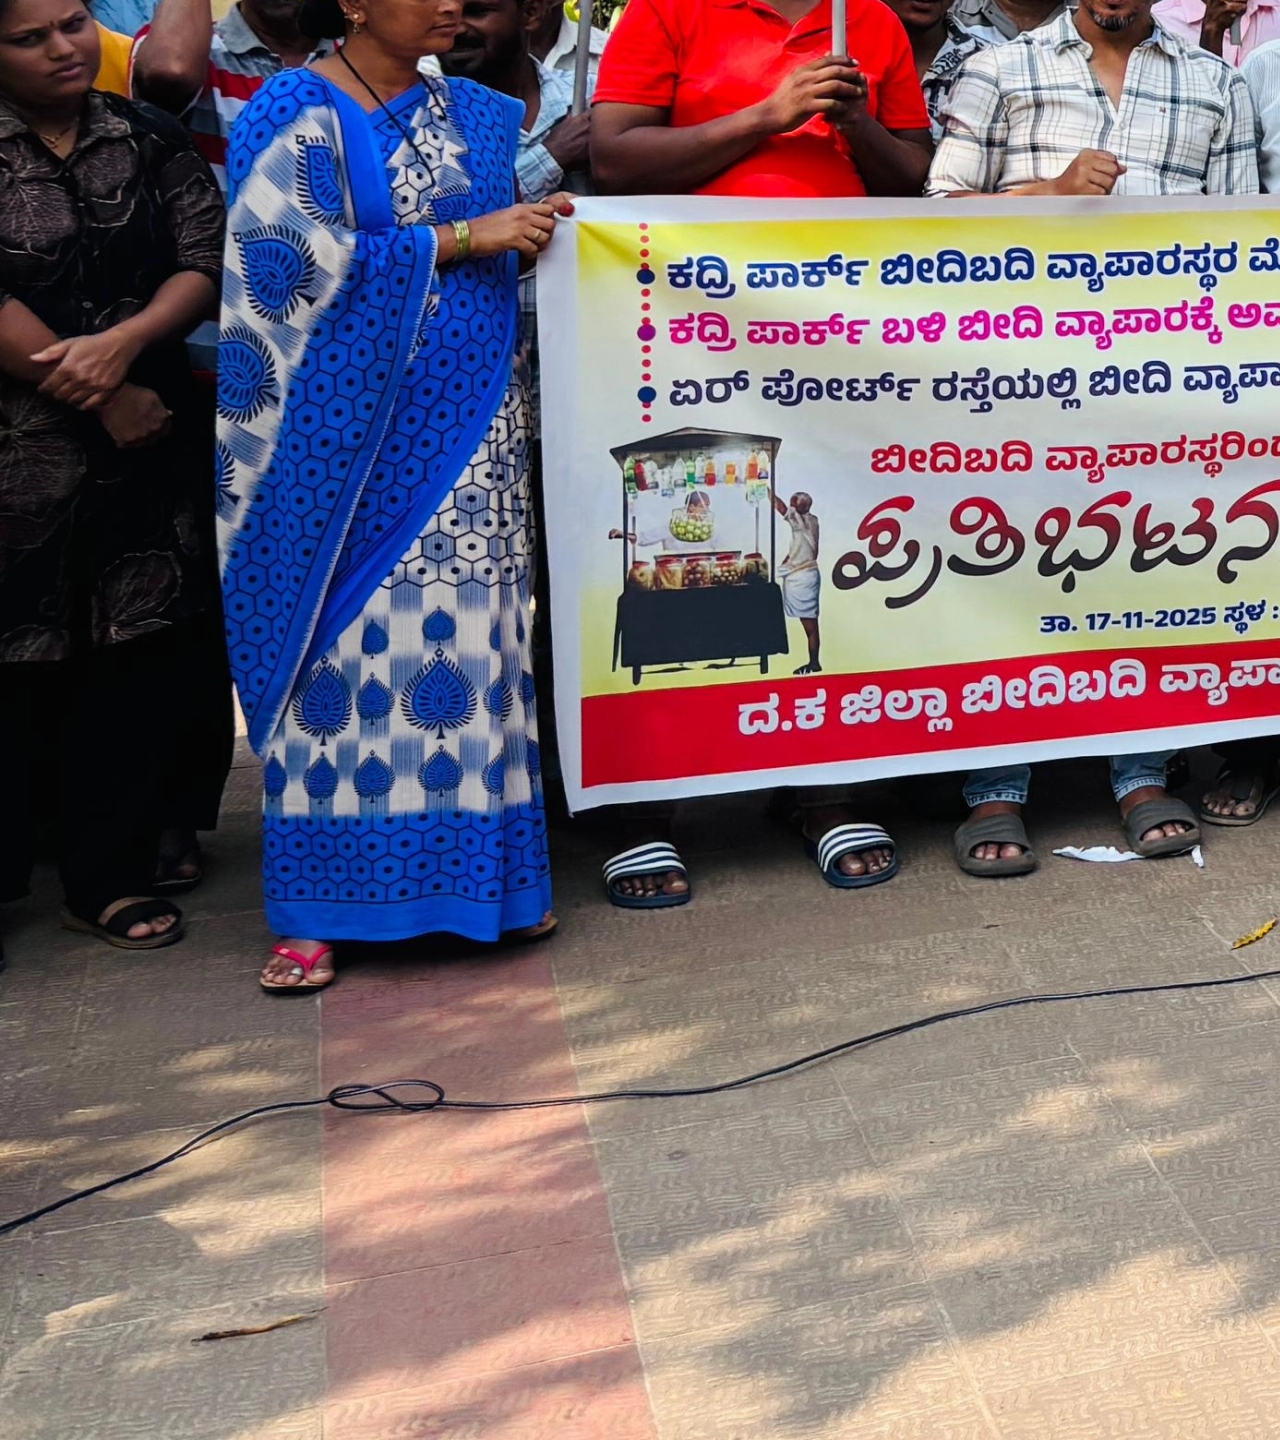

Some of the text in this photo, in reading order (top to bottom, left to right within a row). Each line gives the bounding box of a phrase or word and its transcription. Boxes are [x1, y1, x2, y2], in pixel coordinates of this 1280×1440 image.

[667, 255, 736, 298] ಕದ್ರಿ
[746, 254, 869, 288] ಪಾರ್ಕ್
[881, 247, 1035, 285] ಬೀದಿಬದಿ
[1047, 241, 1238, 292] ವ್ಯಾಪಾರಸ್ಥರ
[669, 312, 736, 351] ಕದ್ರಿ
[747, 313, 870, 345] ಪಾರ್ಕ್
[882, 312, 946, 343] ಬಳಿ
[958, 305, 1043, 342] ಬೀದಿ
[1055, 296, 1223, 349] ವ್ಯಾಪಾರಕ್ಕೆ
[669, 370, 749, 406] ಏರ್
[761, 369, 920, 406] ಪೋರ್ಟ್
[932, 367, 1081, 413] ರಸ್ತೆಯಲ್ಲಿ
[1089, 360, 1171, 396] ಬೀದಿ
[871, 440, 1033, 474] ಬೀದಿಬದಿ
[1040, 614, 1079, 634] ತಾ.
[1085, 607, 1217, 631] 17-11-2025
[737, 688, 825, 735] ದ.ಕ
[840, 684, 953, 733] ಜಿಲ್ಲಾ
[961, 659, 1146, 714] ಬೀದಿಬದಿ
